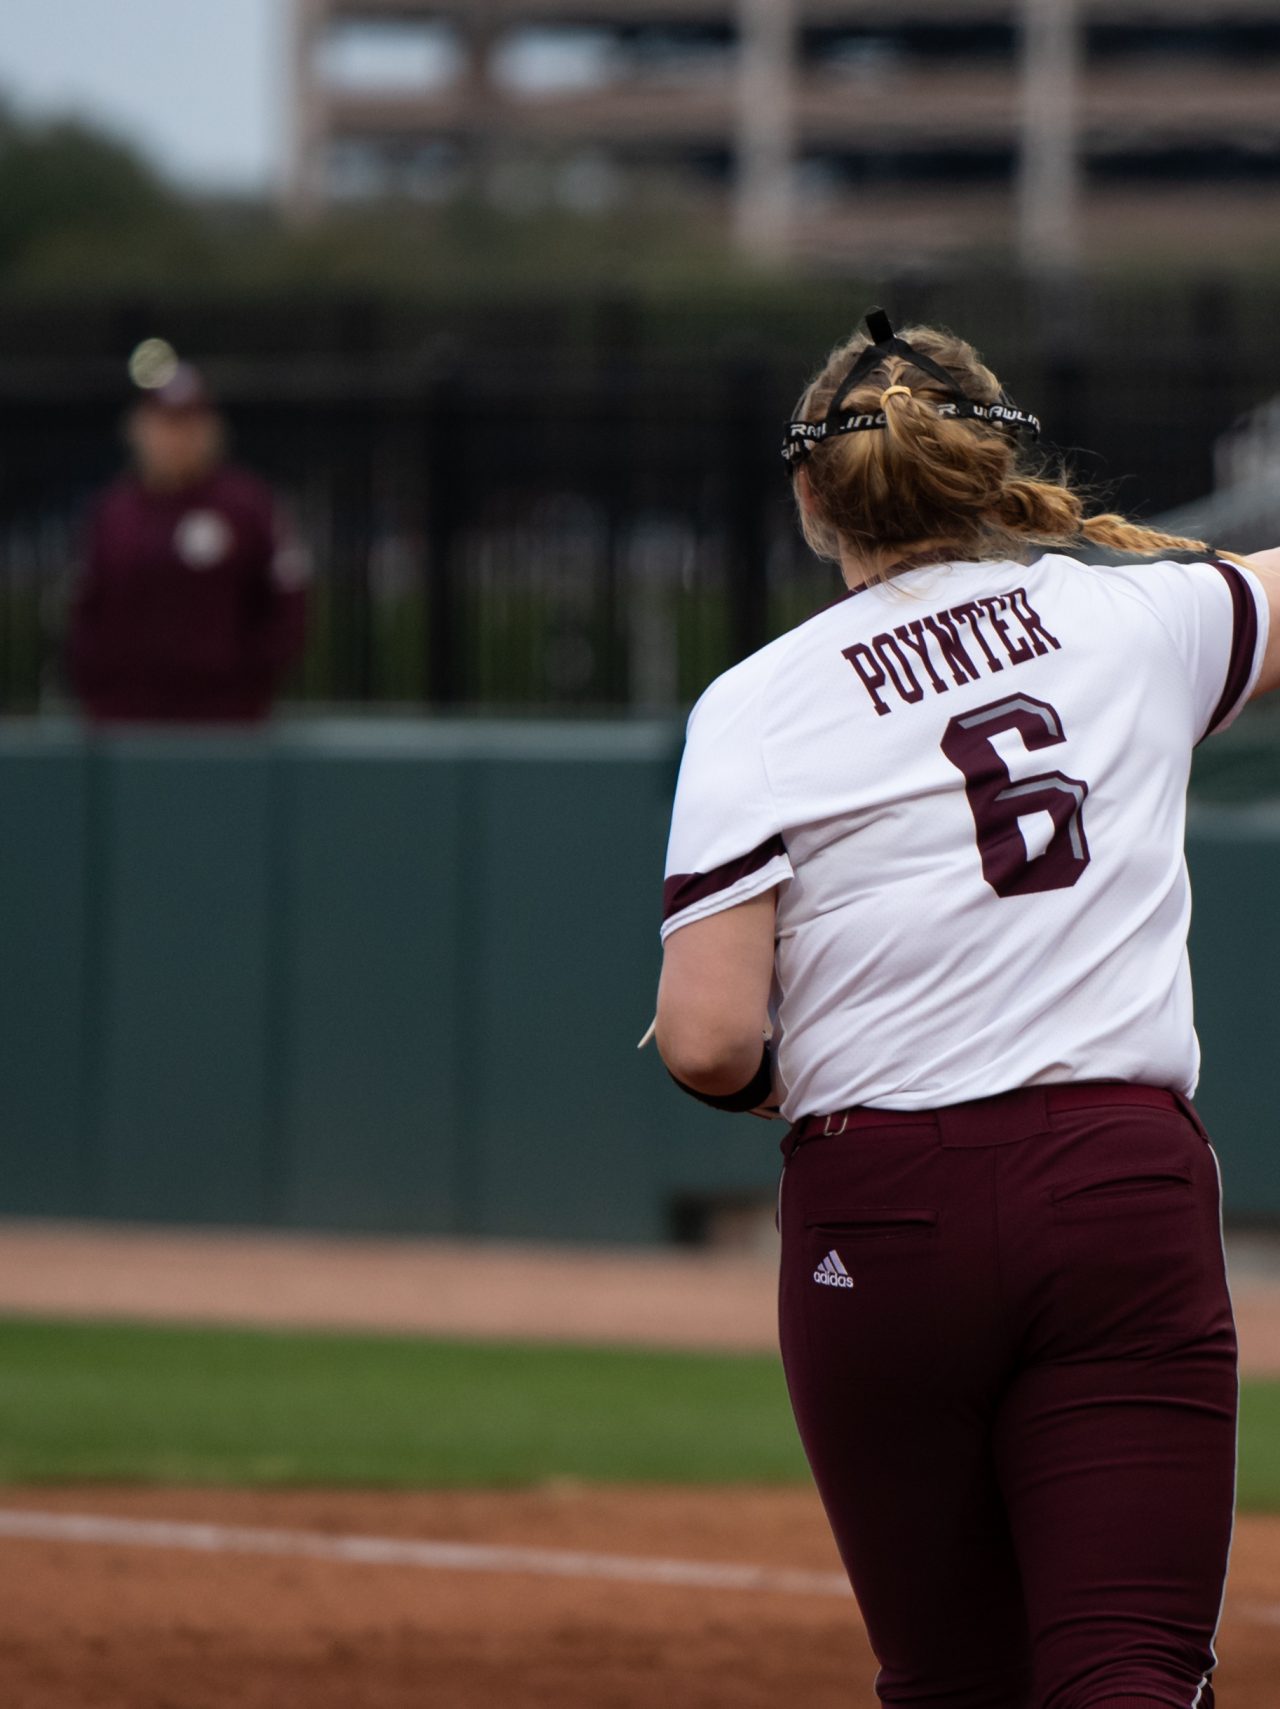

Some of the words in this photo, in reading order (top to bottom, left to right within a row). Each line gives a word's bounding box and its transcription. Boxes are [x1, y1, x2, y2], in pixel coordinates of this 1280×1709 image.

[841, 587, 1062, 716] POYNTER
[940, 691, 1091, 898] 6
[813, 1268, 854, 1288] adidas
